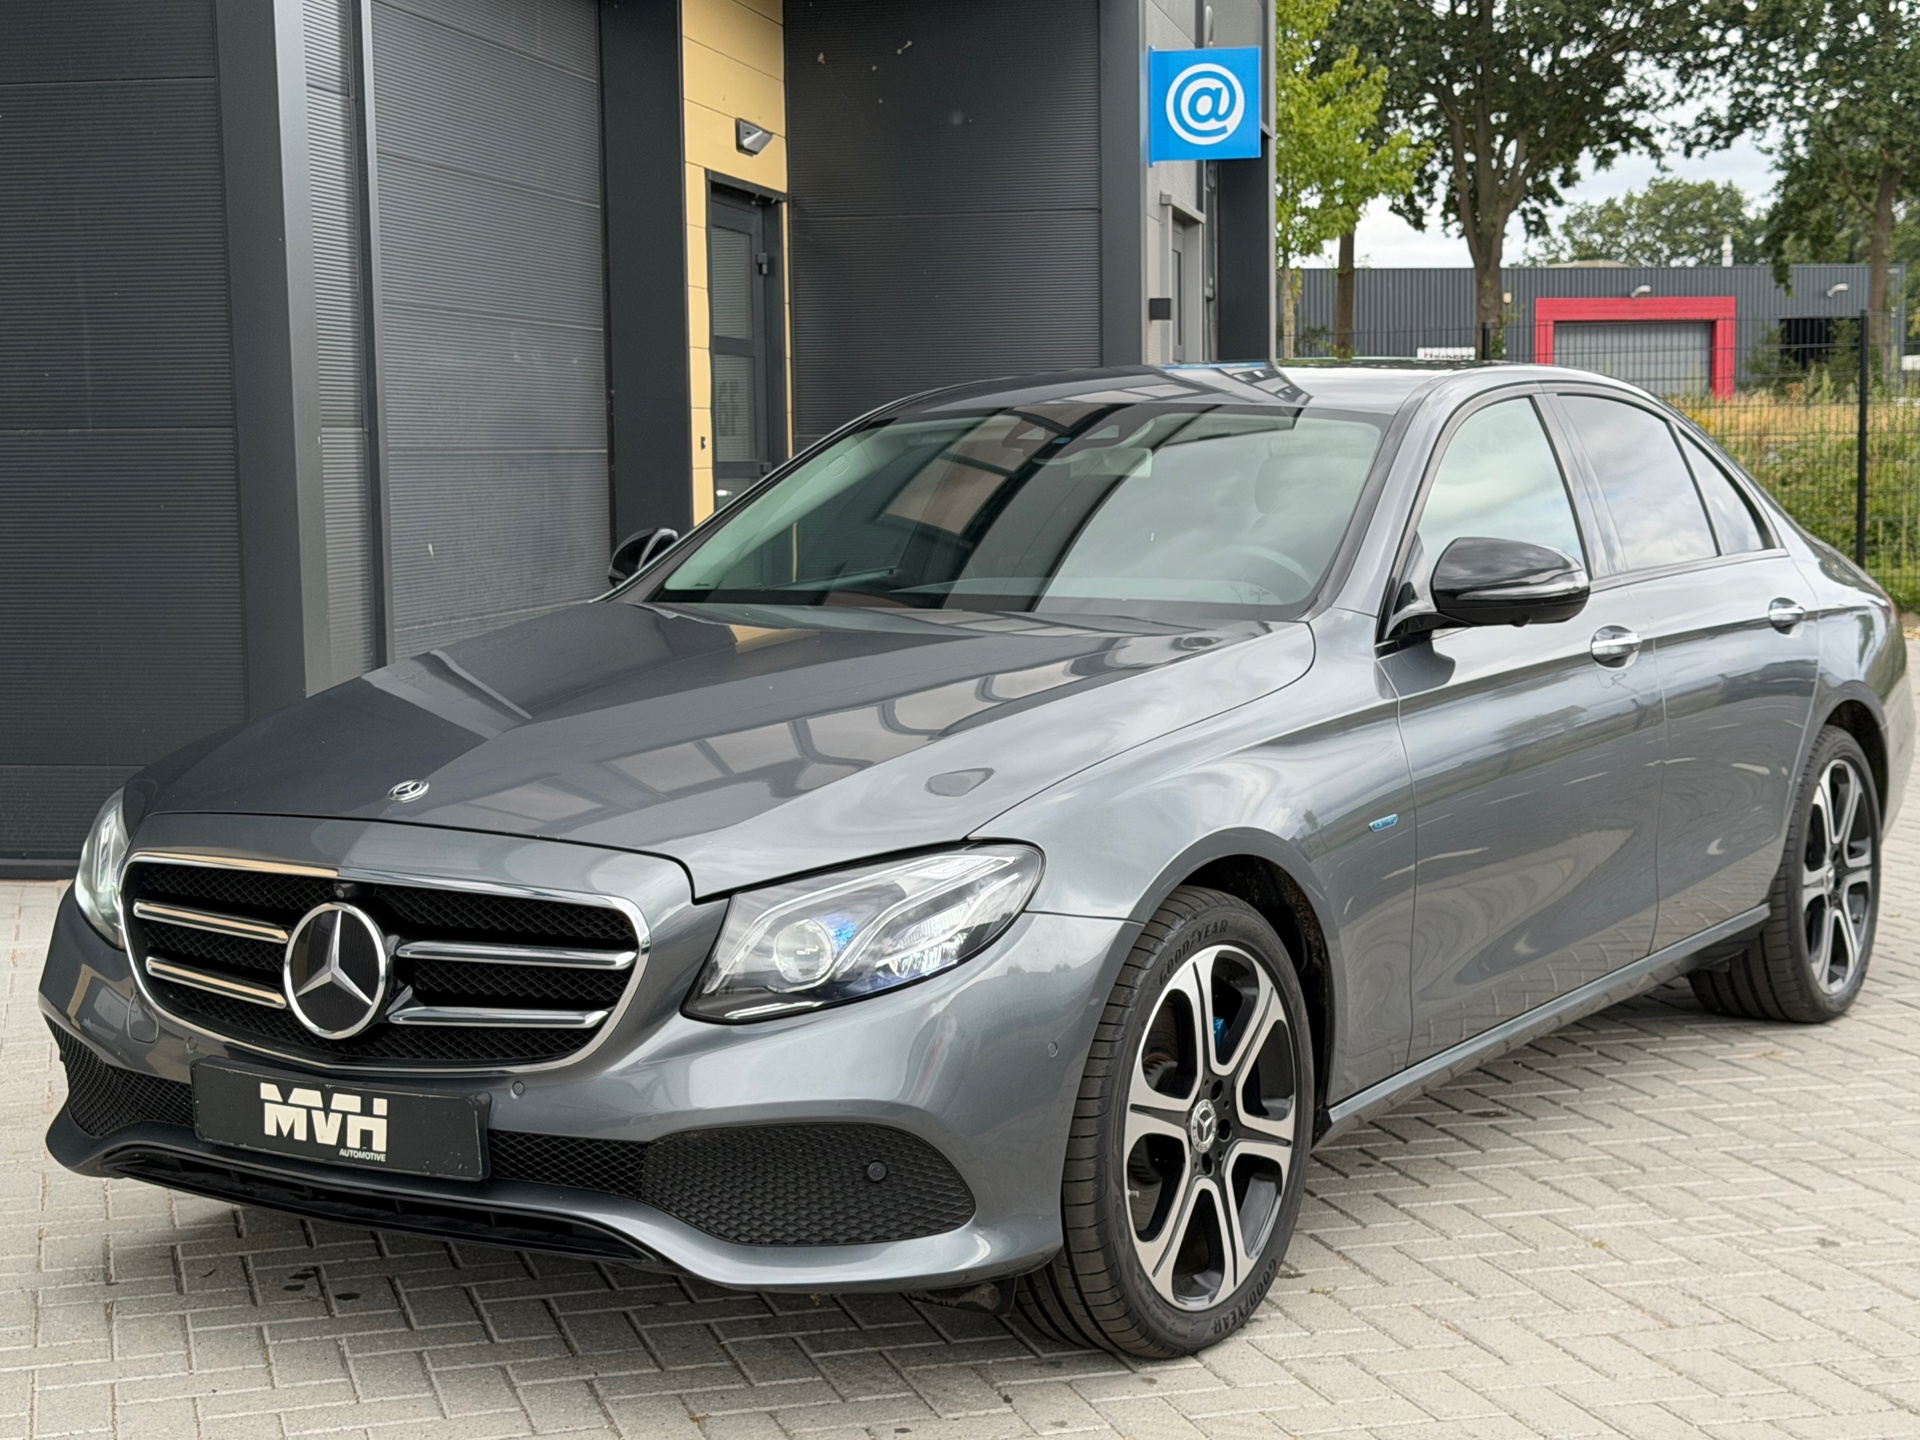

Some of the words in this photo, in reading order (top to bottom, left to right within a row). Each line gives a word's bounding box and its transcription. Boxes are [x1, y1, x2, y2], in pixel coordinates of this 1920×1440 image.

[260, 1082, 388, 1151] MVH
[339, 1148, 387, 1163] AUTOMOTIVE
[1213, 1258, 1277, 1335] GOODYEAR
